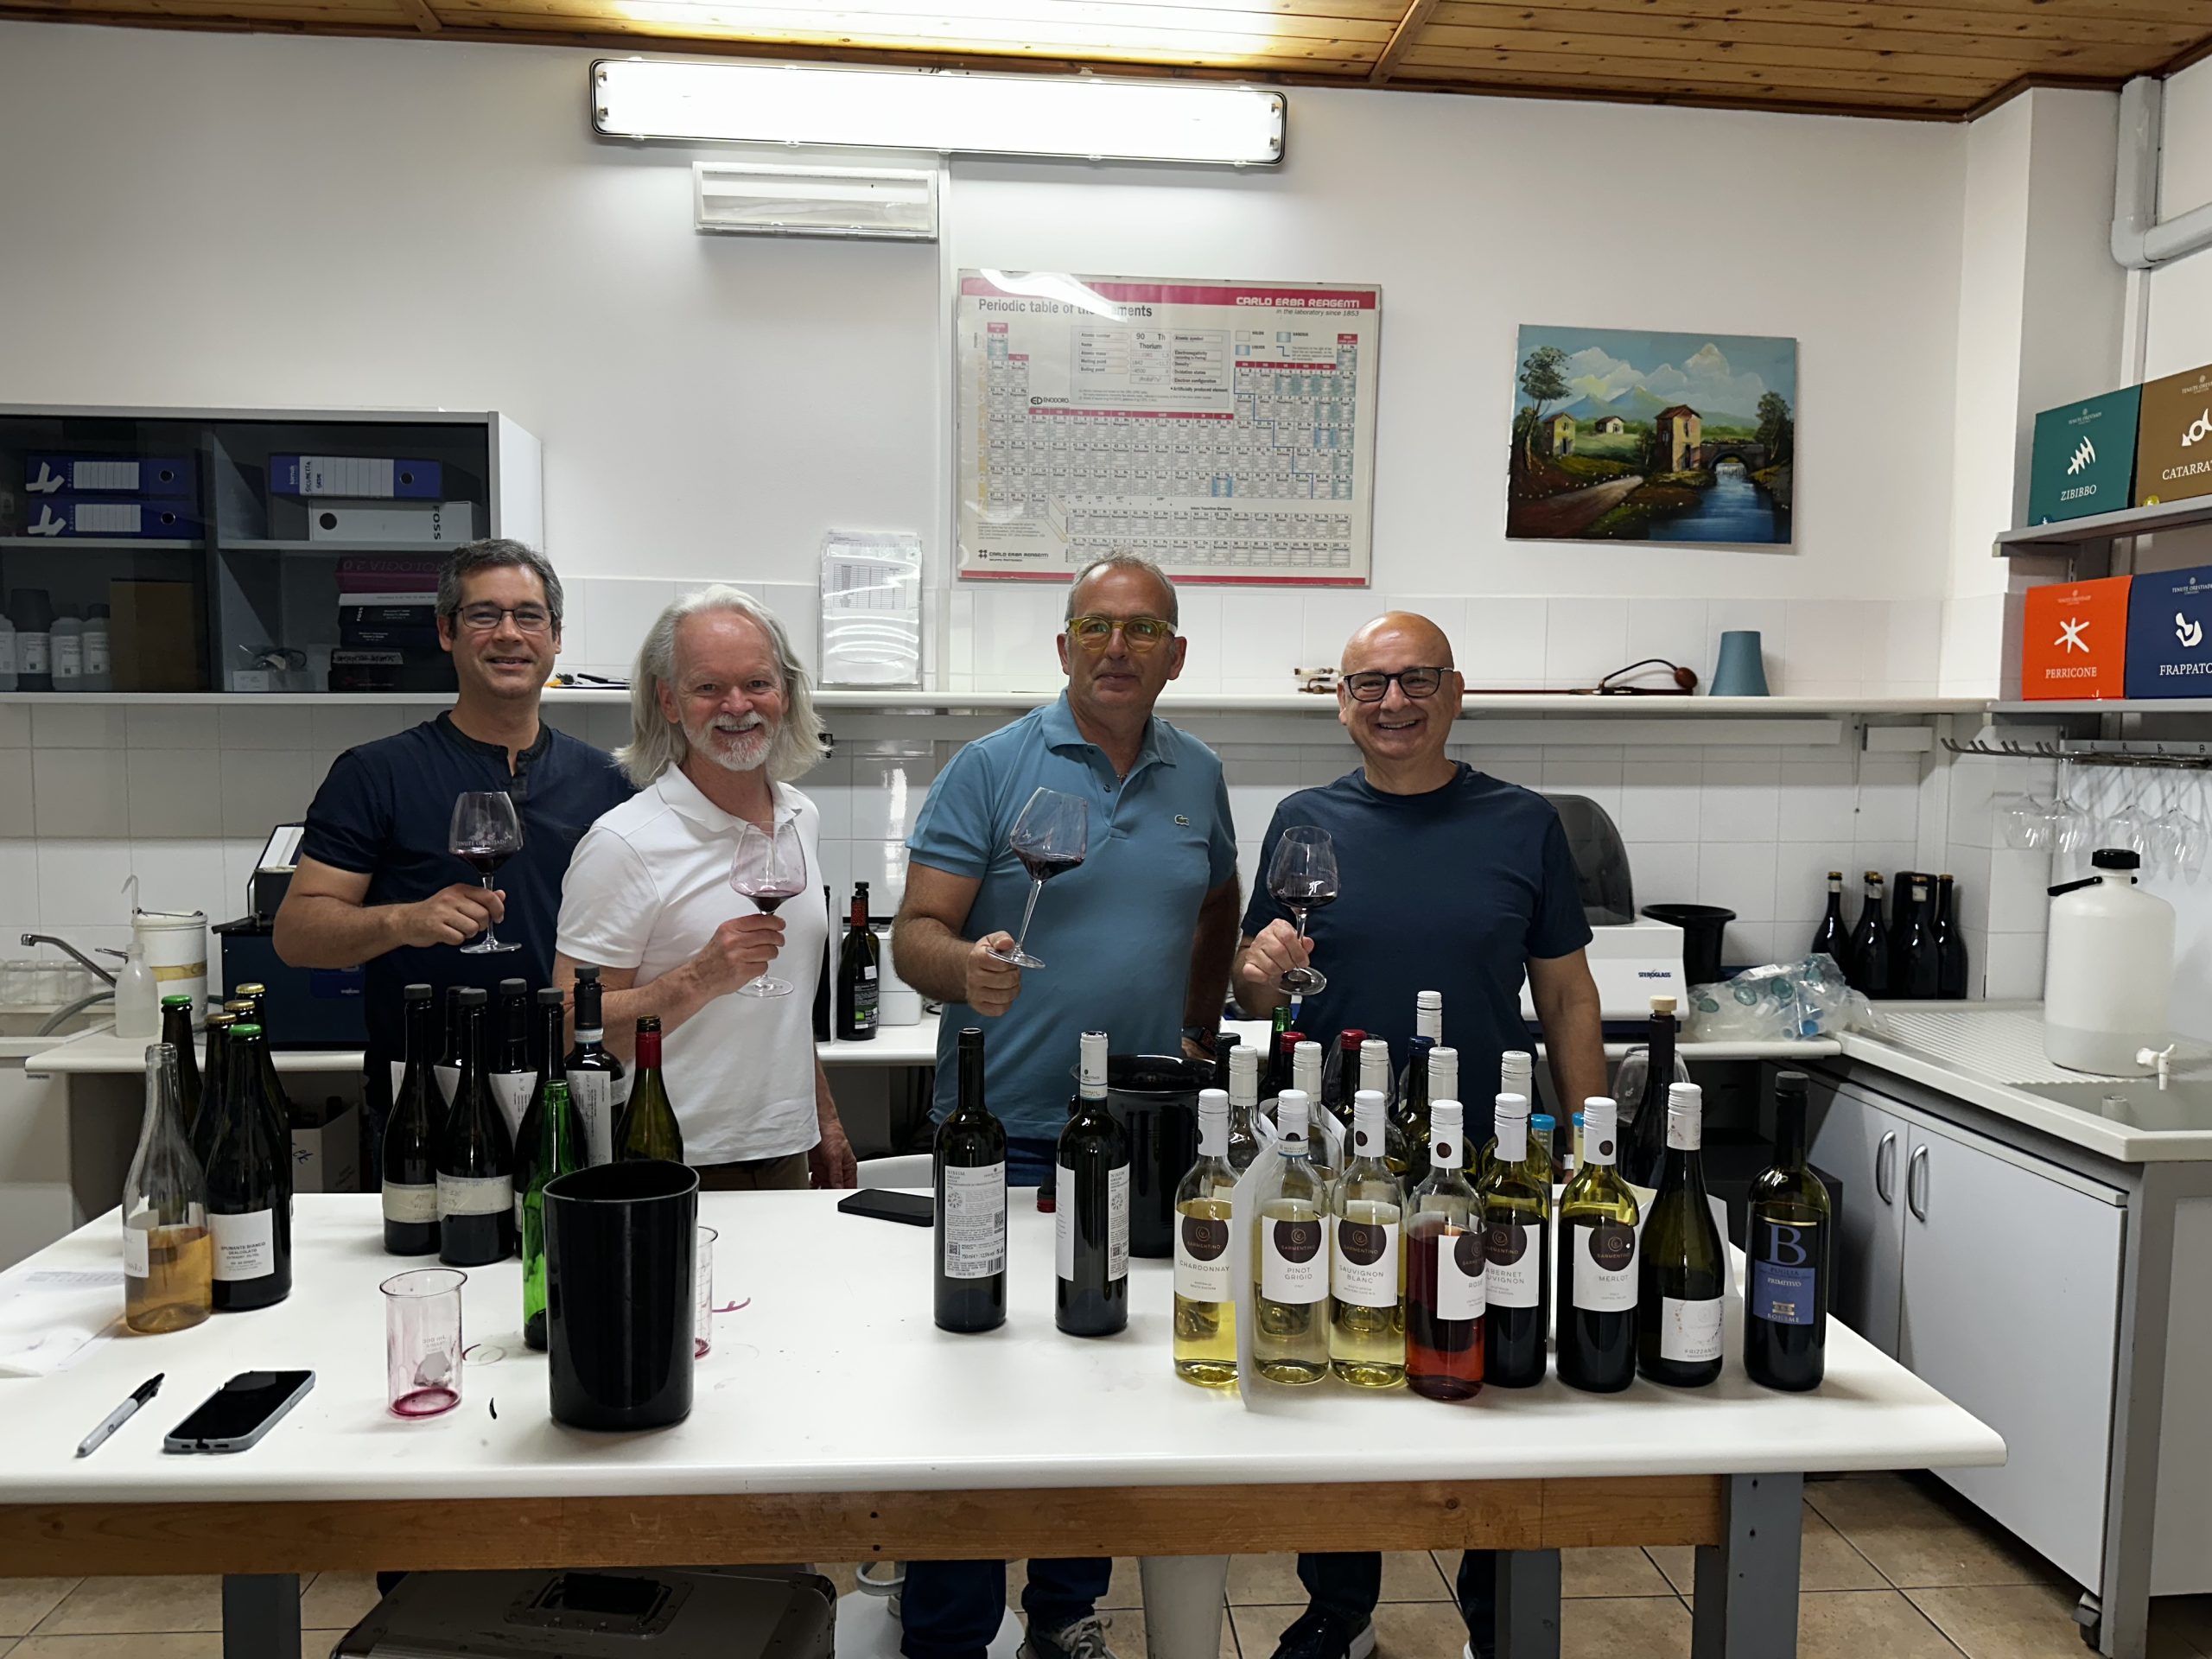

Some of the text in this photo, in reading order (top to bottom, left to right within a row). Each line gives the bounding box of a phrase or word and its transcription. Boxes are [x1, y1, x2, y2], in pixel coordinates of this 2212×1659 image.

[979, 299, 1026, 313] Periodic
[1030, 301, 1058, 314] table
[1063, 303, 1075, 314] of
[1236, 296, 1360, 308] CARLO ERBA REAGENTI
[2061, 484, 2097, 500] ZIBIBBO
[2045, 666, 2097, 679] PERRICONE
[1764, 1223, 1807, 1266] B
[1179, 1260, 1230, 1272] CHARDONNAY
[1339, 1265, 1384, 1278] SAUVIGNON
[1485, 1267, 1522, 1277] ABERNET
[1347, 1274, 1374, 1284] BLANC
[1486, 1275, 1524, 1284] UVIGNON
[1767, 1277, 1802, 1287] PRIMITIVO
